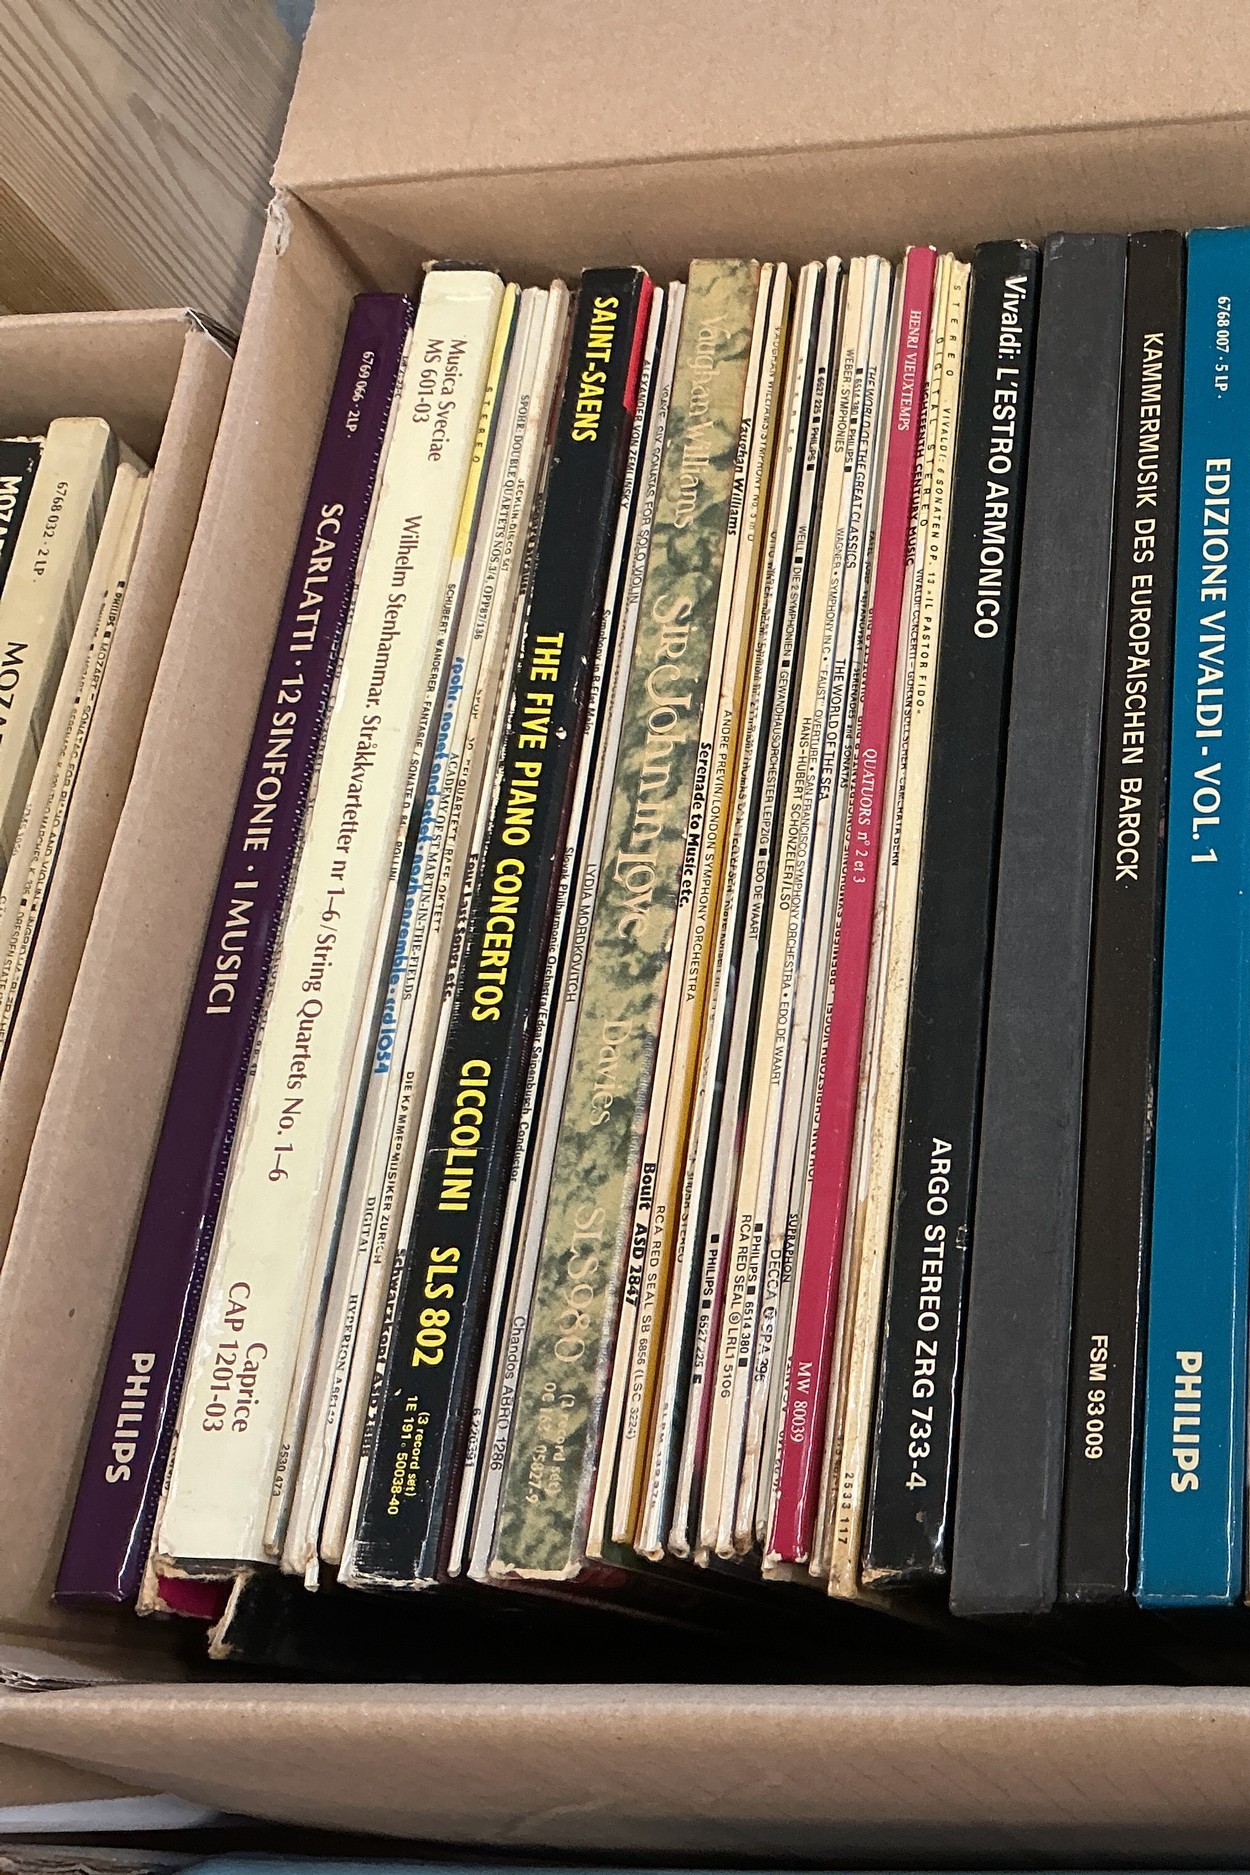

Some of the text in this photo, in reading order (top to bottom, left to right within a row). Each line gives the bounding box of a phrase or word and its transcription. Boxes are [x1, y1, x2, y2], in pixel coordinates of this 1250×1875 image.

[412, 338, 444, 423] MS 601-03
[428, 339, 467, 461] Musica Sveciae
[898, 311, 922, 430] HENRI VIEUXTEMPS
[42, 482, 68, 537] 6768 032
[495, 435, 524, 537] DOUBLE QUARTETS
[724, 477, 746, 535] Williams
[820, 658, 846, 774] THE WORLD OF THE
[1191, 458, 1231, 864] EDIZIONE VIVALDI VOL. 1
[207, 504, 343, 1013] SCARLATTI 12 SINFONIE MUSICI
[277, 515, 422, 1135] Wilhelm Stenhammar. Stråkkvartetter nr Quartets No.
[589, 421, 719, 1125] Williams John Love Davies
[676, 742, 715, 907] Serenade to Music etc.
[858, 748, 878, 824] QUATUORS
[412, 297, 618, 1366] SAINT-SAENS THE FIVE PIANO CONCERTOS CICCOLINI SLS 802
[906, 276, 1027, 1490] Vivaldi: ARMONICO ARGO STEREO ZRG 733-4
[1089, 332, 1163, 1381] KAMMERMUSIK DES EUROPÄISCHEN BAROCK FSM
[565, 863, 596, 1001] LYDIA MORDKOVITCH
[687, 853, 715, 1002] SYMPHONY ORCHESTRA
[623, 1163, 658, 1306] Boult ASD 2847
[747, 1236, 762, 1281] PHILIPS
[202, 1282, 251, 1431] CAP 1201-03
[231, 1342, 268, 1432] Caprice
[502, 1316, 527, 1378] Chandos
[790, 1362, 813, 1441] MW 80039
[106, 1353, 155, 1482] PHILIPS
[1171, 1351, 1202, 1492] PHILIPS
